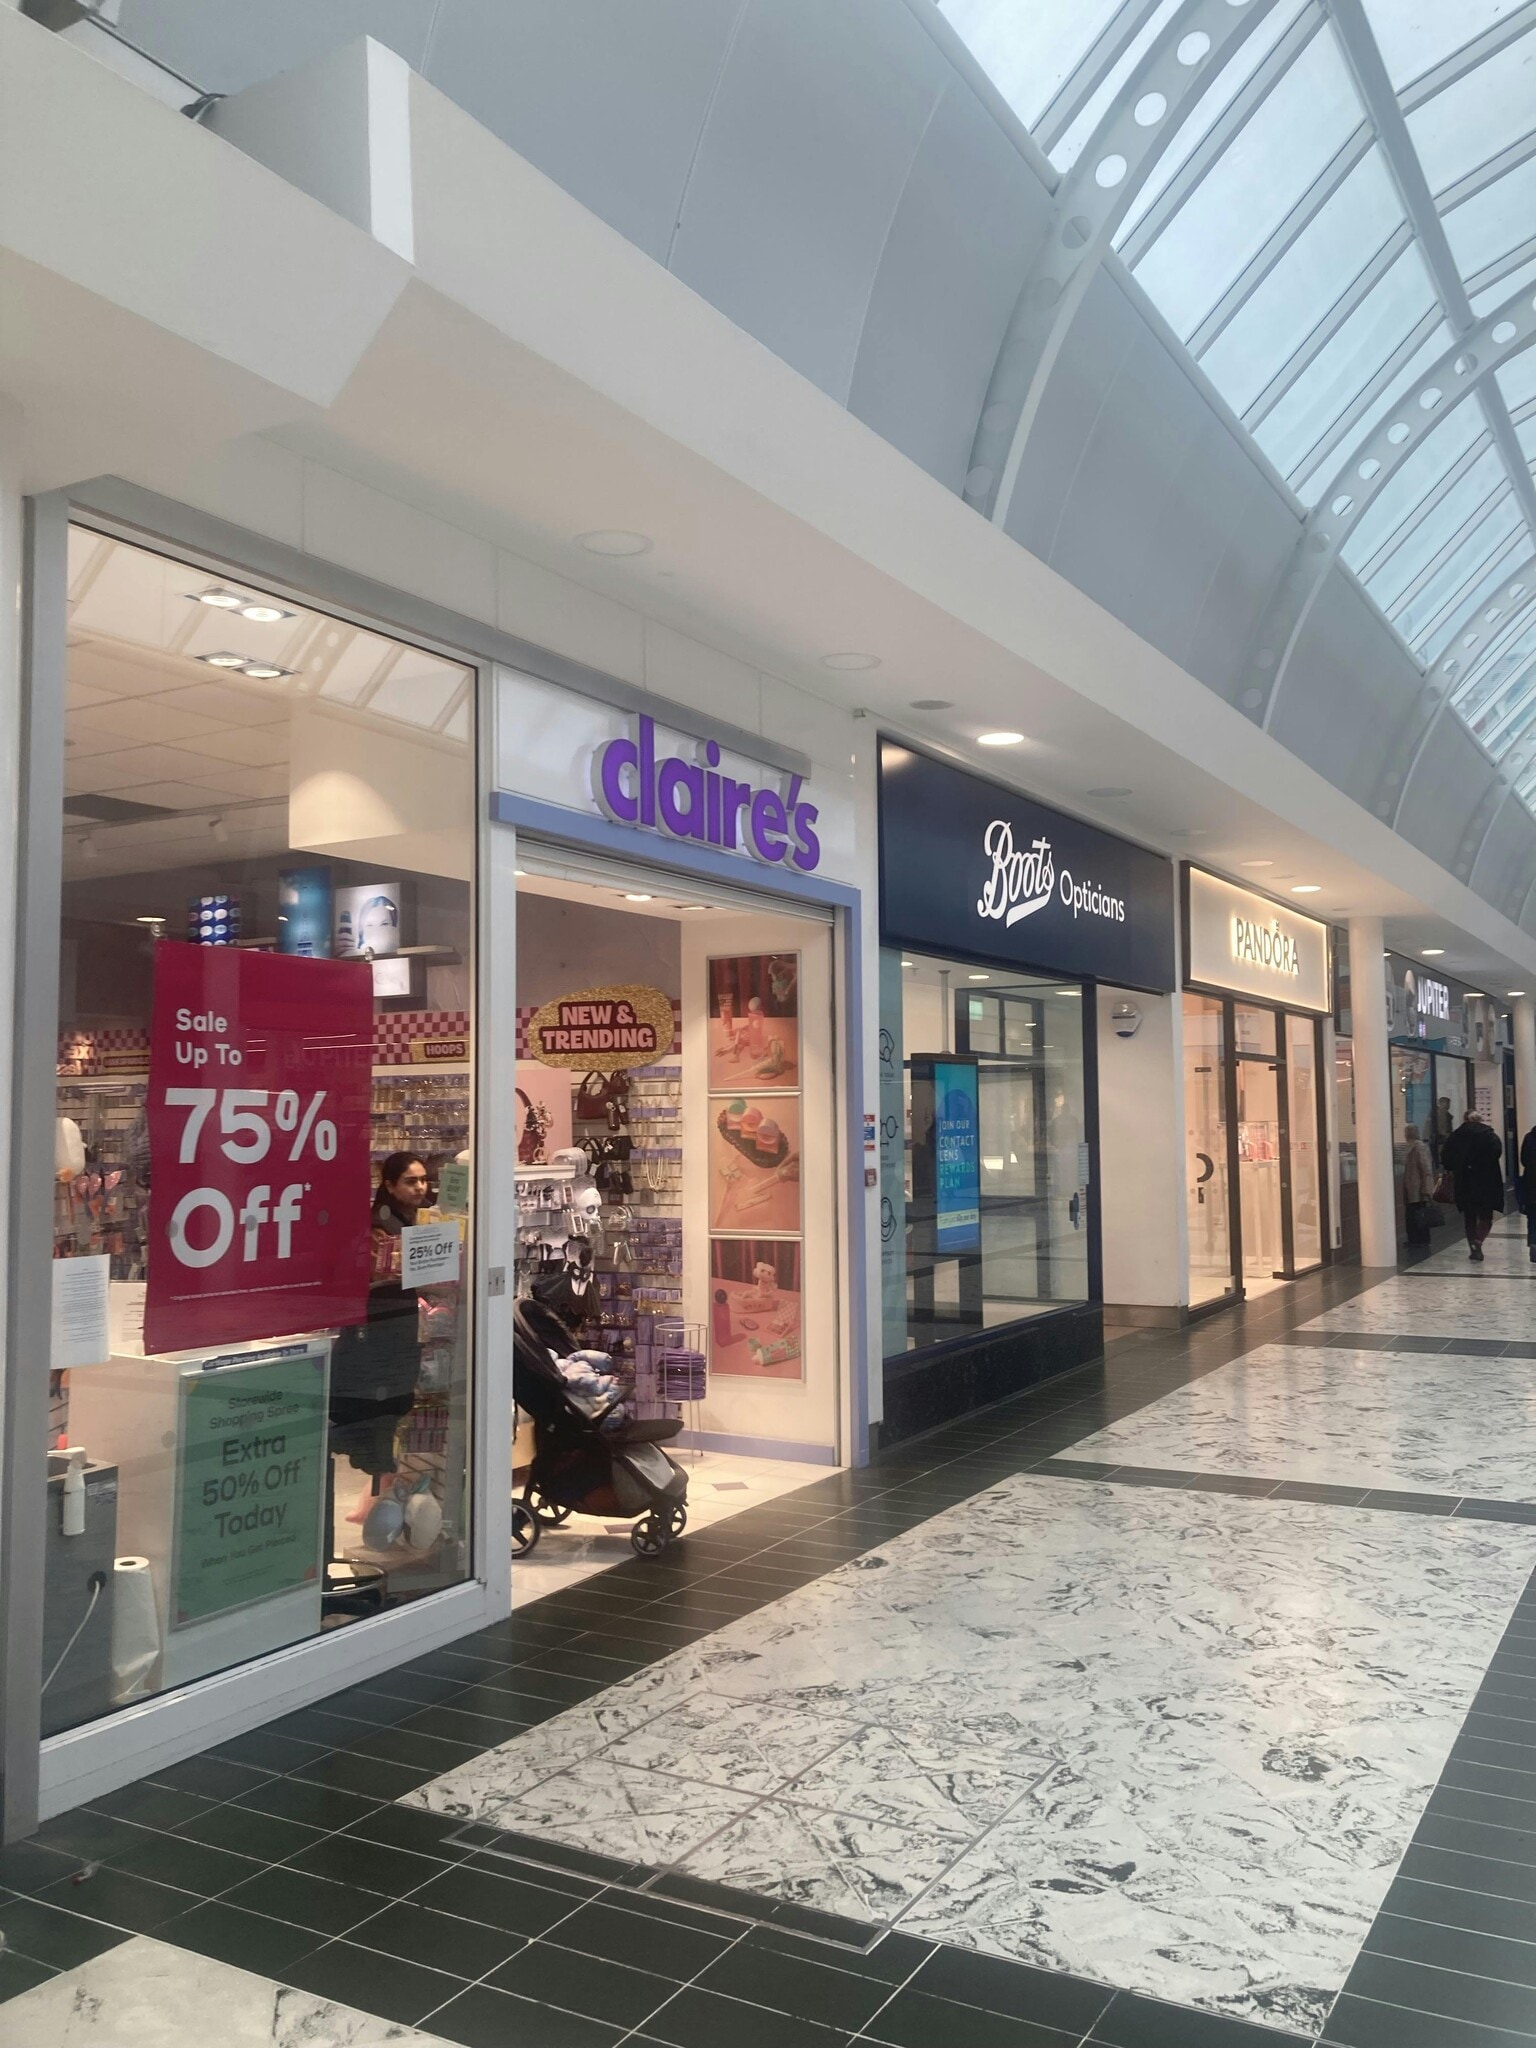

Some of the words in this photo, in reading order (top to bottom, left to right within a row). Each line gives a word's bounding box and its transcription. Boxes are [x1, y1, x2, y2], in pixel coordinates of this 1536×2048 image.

[600, 712, 821, 872] claire's
[977, 819, 1055, 929] Boots
[1060, 869, 1125, 922] Opticians
[1236, 916, 1300, 976] PANDORA
[1417, 975, 1450, 1021] JUPITER
[175, 1009, 228, 1033] Sale
[561, 1005, 614, 1027] NEW
[615, 1004, 635, 1026] &
[425, 1042, 464, 1056] HOOPS
[541, 1027, 655, 1051] TRENDING
[175, 1041, 208, 1069] Up
[215, 1042, 243, 1067] To
[164, 1087, 338, 1165] 75%
[938, 1119, 955, 1133] JOIN
[956, 1118, 971, 1131] OUR
[939, 1134, 975, 1149] CONTACT
[939, 1149, 959, 1162] LENS
[939, 1161, 976, 1175] REWARDS
[939, 1176, 961, 1190] PLAN
[409, 1245, 433, 1260] 25%
[228, 1390, 283, 1410] Storewide
[208, 1410, 265, 1430] Shopping
[266, 1403, 300, 1419] Spree
[222, 1434, 286, 1467] Extra
[201, 1469, 261, 1507] 50%
[214, 1502, 288, 1539] Today
